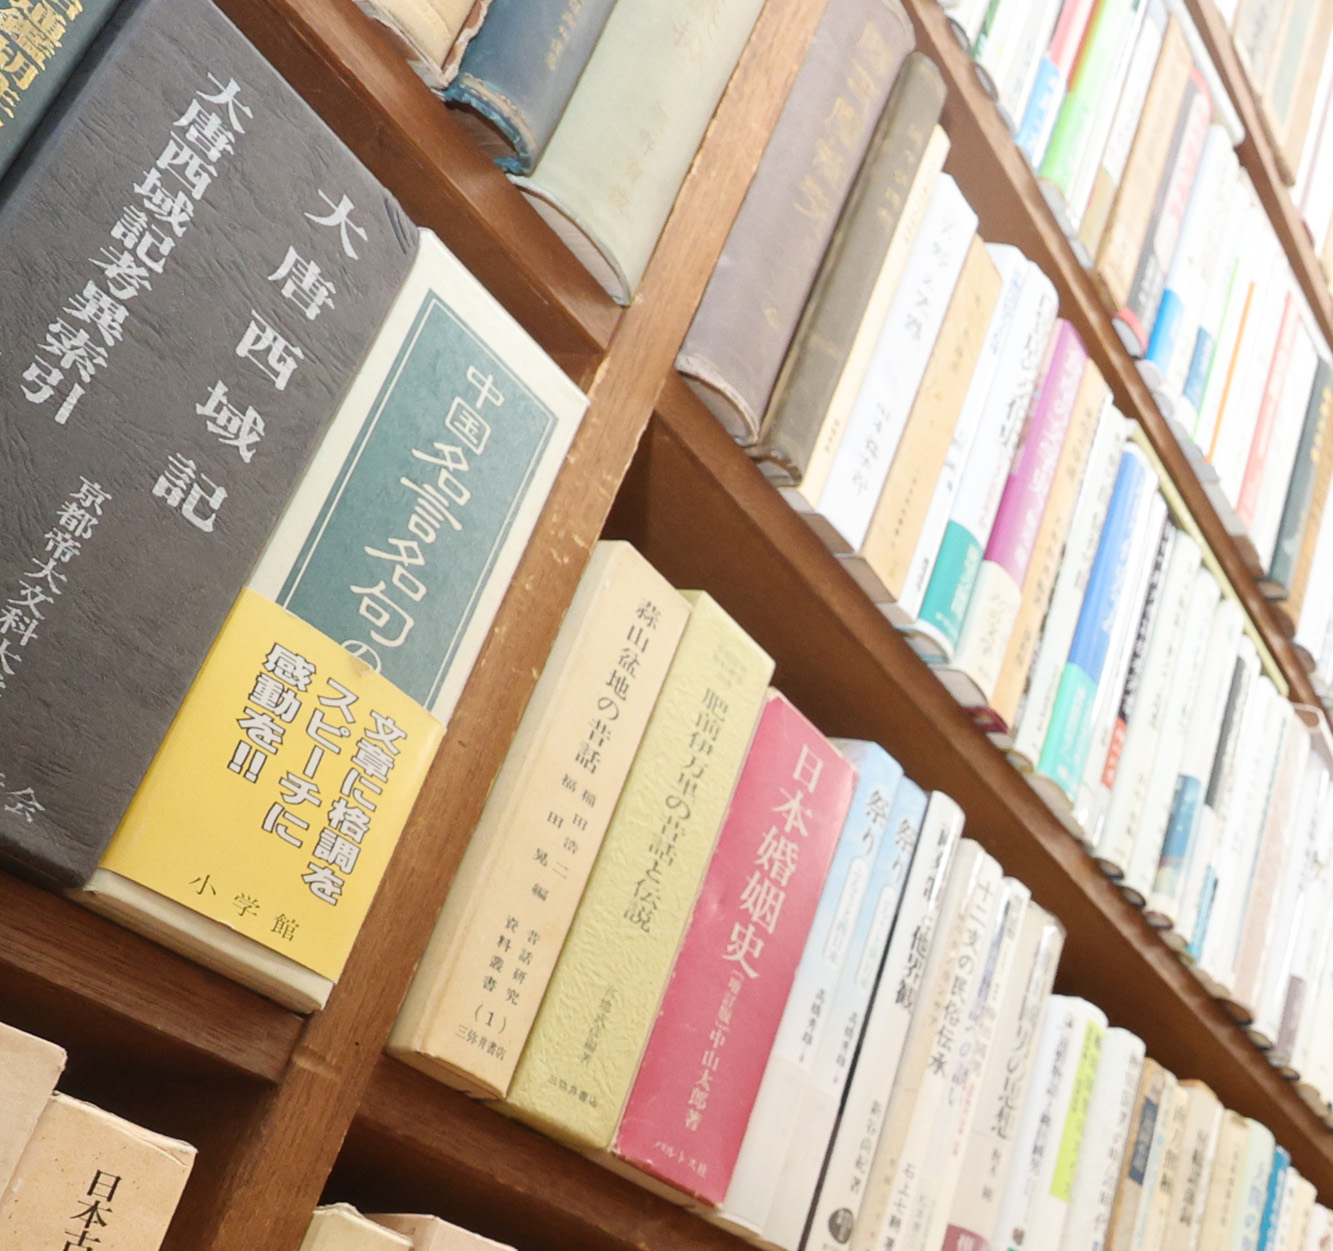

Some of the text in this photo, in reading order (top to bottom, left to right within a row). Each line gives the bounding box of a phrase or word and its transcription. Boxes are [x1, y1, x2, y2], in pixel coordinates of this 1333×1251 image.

[20, 71, 254, 425] 大唐西域記考異索引
[151, 189, 368, 532] 大唐西域記
[573, 599, 662, 776] 蒜山盆地の昔話
[261, 677, 359, 848] スピーチに
[301, 709, 407, 906] 文章に格調を
[623, 686, 733, 934] 肥前伊万里の昔話と伝説
[533, 772, 578, 867] 福田晃
[552, 786, 597, 881] 稲田浩二
[719, 742, 827, 982] 日本婚姻史
[857, 786, 893, 858] 祭り
[188, 871, 302, 943] 小学館
[530, 881, 549, 904] 編
[481, 915, 520, 993] 資料叢書
[502, 927, 543, 1007] 昔話研究
[453, 1023, 510, 1063] 三弥井書店
[683, 1030, 728, 1131] 中山太郎著
